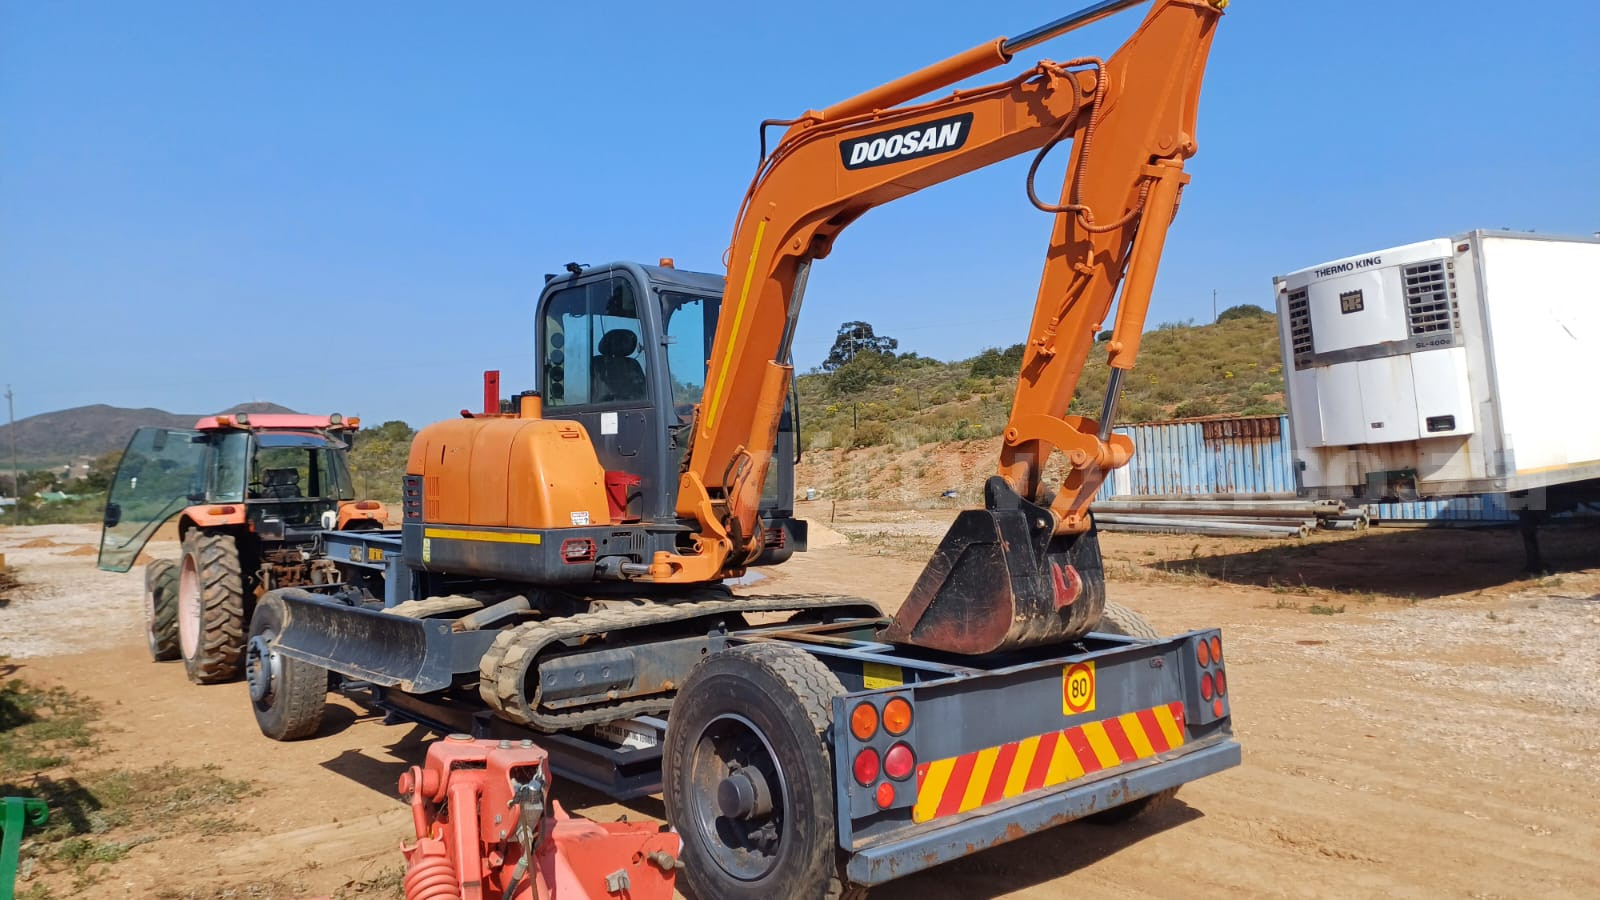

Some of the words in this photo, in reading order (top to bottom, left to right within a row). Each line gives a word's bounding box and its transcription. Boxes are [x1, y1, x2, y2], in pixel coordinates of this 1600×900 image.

[849, 121, 962, 166] DOOSAN
[1315, 262, 1354, 279] THERMO
[1355, 256, 1382, 269] KING
[1071, 677, 1087, 699] 80
